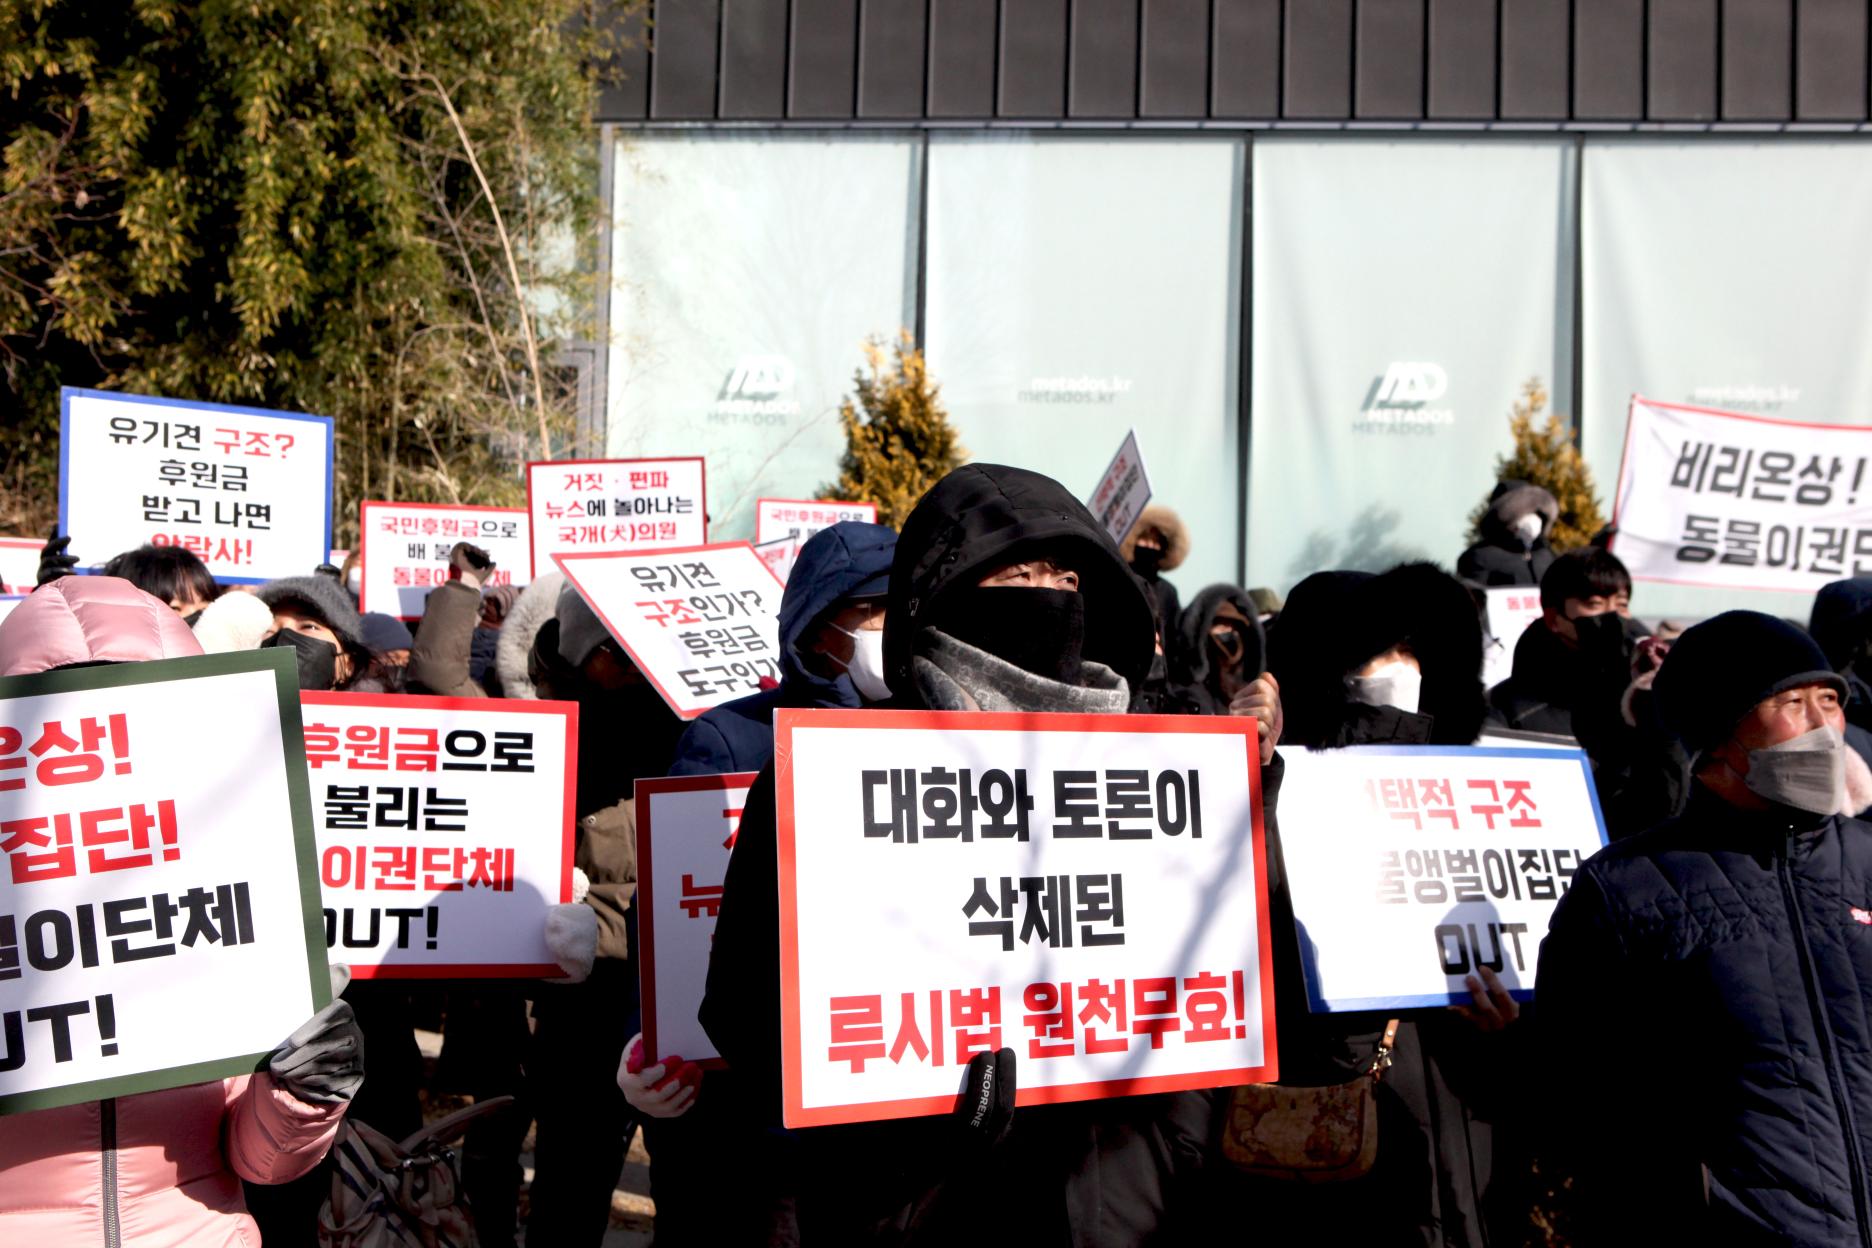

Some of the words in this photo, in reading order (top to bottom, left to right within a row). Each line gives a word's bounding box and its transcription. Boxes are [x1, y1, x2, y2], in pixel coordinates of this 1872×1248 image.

[108, 416, 201, 451] 유기견
[213, 427, 295, 459] 구조?
[158, 459, 249, 492] 후원금
[563, 473, 603, 491] 거짓
[629, 471, 669, 490] 편파
[1670, 440, 1867, 506] 비리온상!
[142, 495, 202, 524] 받고
[214, 501, 271, 530] 나면
[380, 515, 518, 538] 국민후원금으로
[546, 499, 607, 519] 뉴스에
[408, 543, 426, 560] 배
[630, 561, 722, 593] 유기견
[634, 590, 768, 628] 구조인가?
[678, 625, 770, 659] 후원금
[303, 723, 535, 773] 후원금으로
[324, 785, 469, 831] 불리는
[861, 766, 1034, 843] 대화와
[1053, 769, 1202, 840] 토론이
[1466, 779, 1543, 830] 구조
[0, 799, 181, 885] 집단!
[321, 845, 515, 892] 이권단체
[962, 873, 1126, 951] 삭제된
[1434, 922, 1528, 976] OUT
[828, 986, 1002, 1074] 루시법
[1022, 970, 1247, 1059] 원천무효!
[970, 1064, 994, 1128] NEOPRENE
